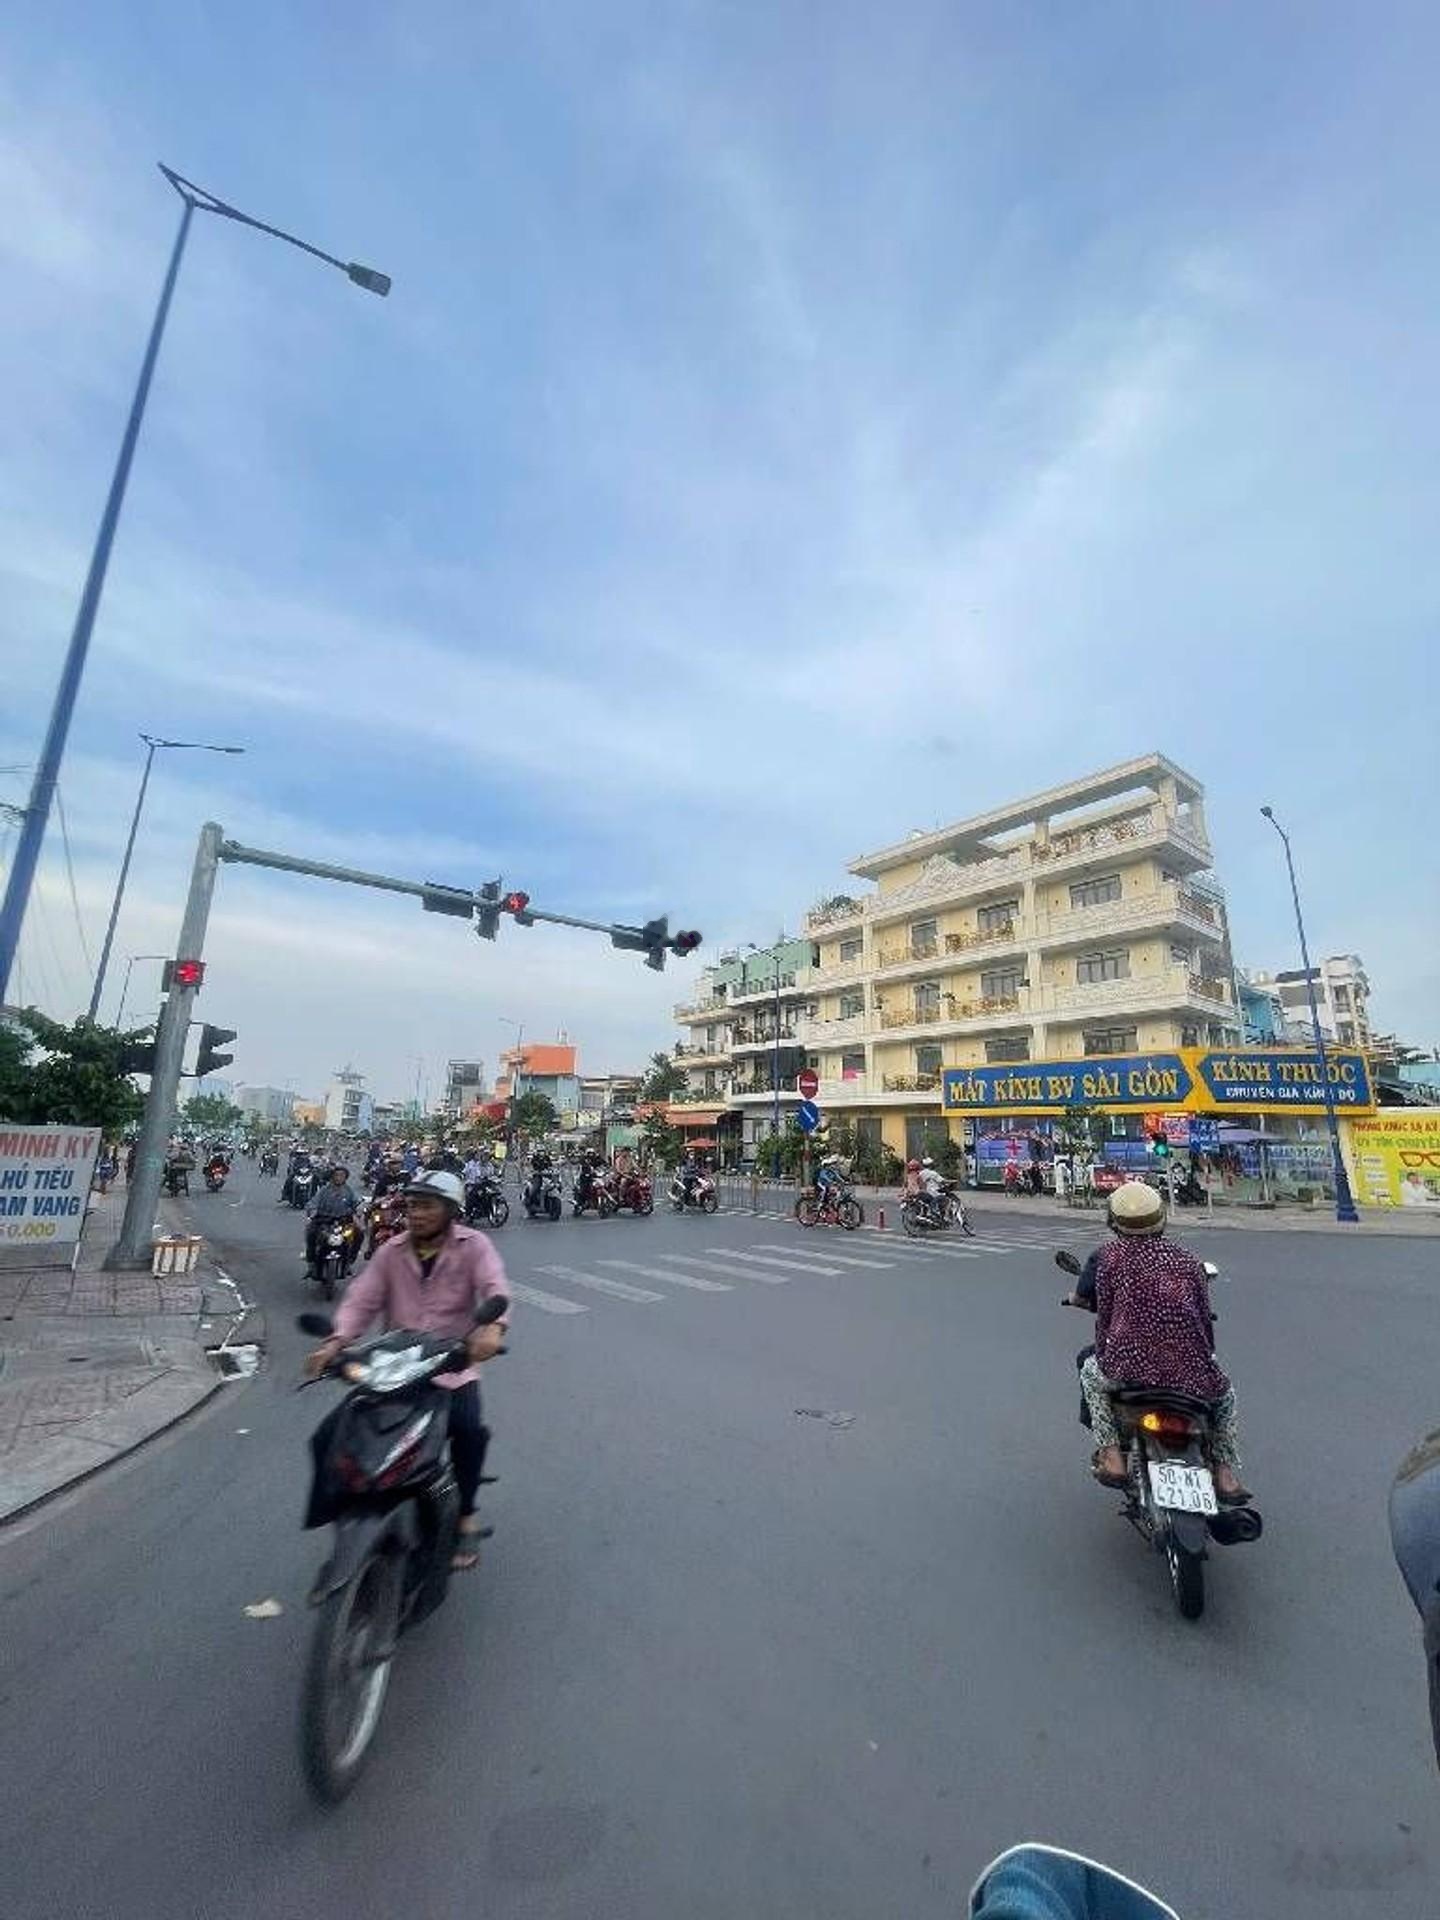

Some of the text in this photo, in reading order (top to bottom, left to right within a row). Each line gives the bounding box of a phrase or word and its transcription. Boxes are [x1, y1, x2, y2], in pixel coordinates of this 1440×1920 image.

[994, 1070, 1044, 1101] KÍNH
[1047, 1076, 1075, 1099] BV
[1082, 1066, 1120, 1098] SÀI
[1128, 1061, 1179, 1097] GÒN
[1211, 1056, 1272, 1081] KÍNH
[32, 1196, 81, 1216] VANG
